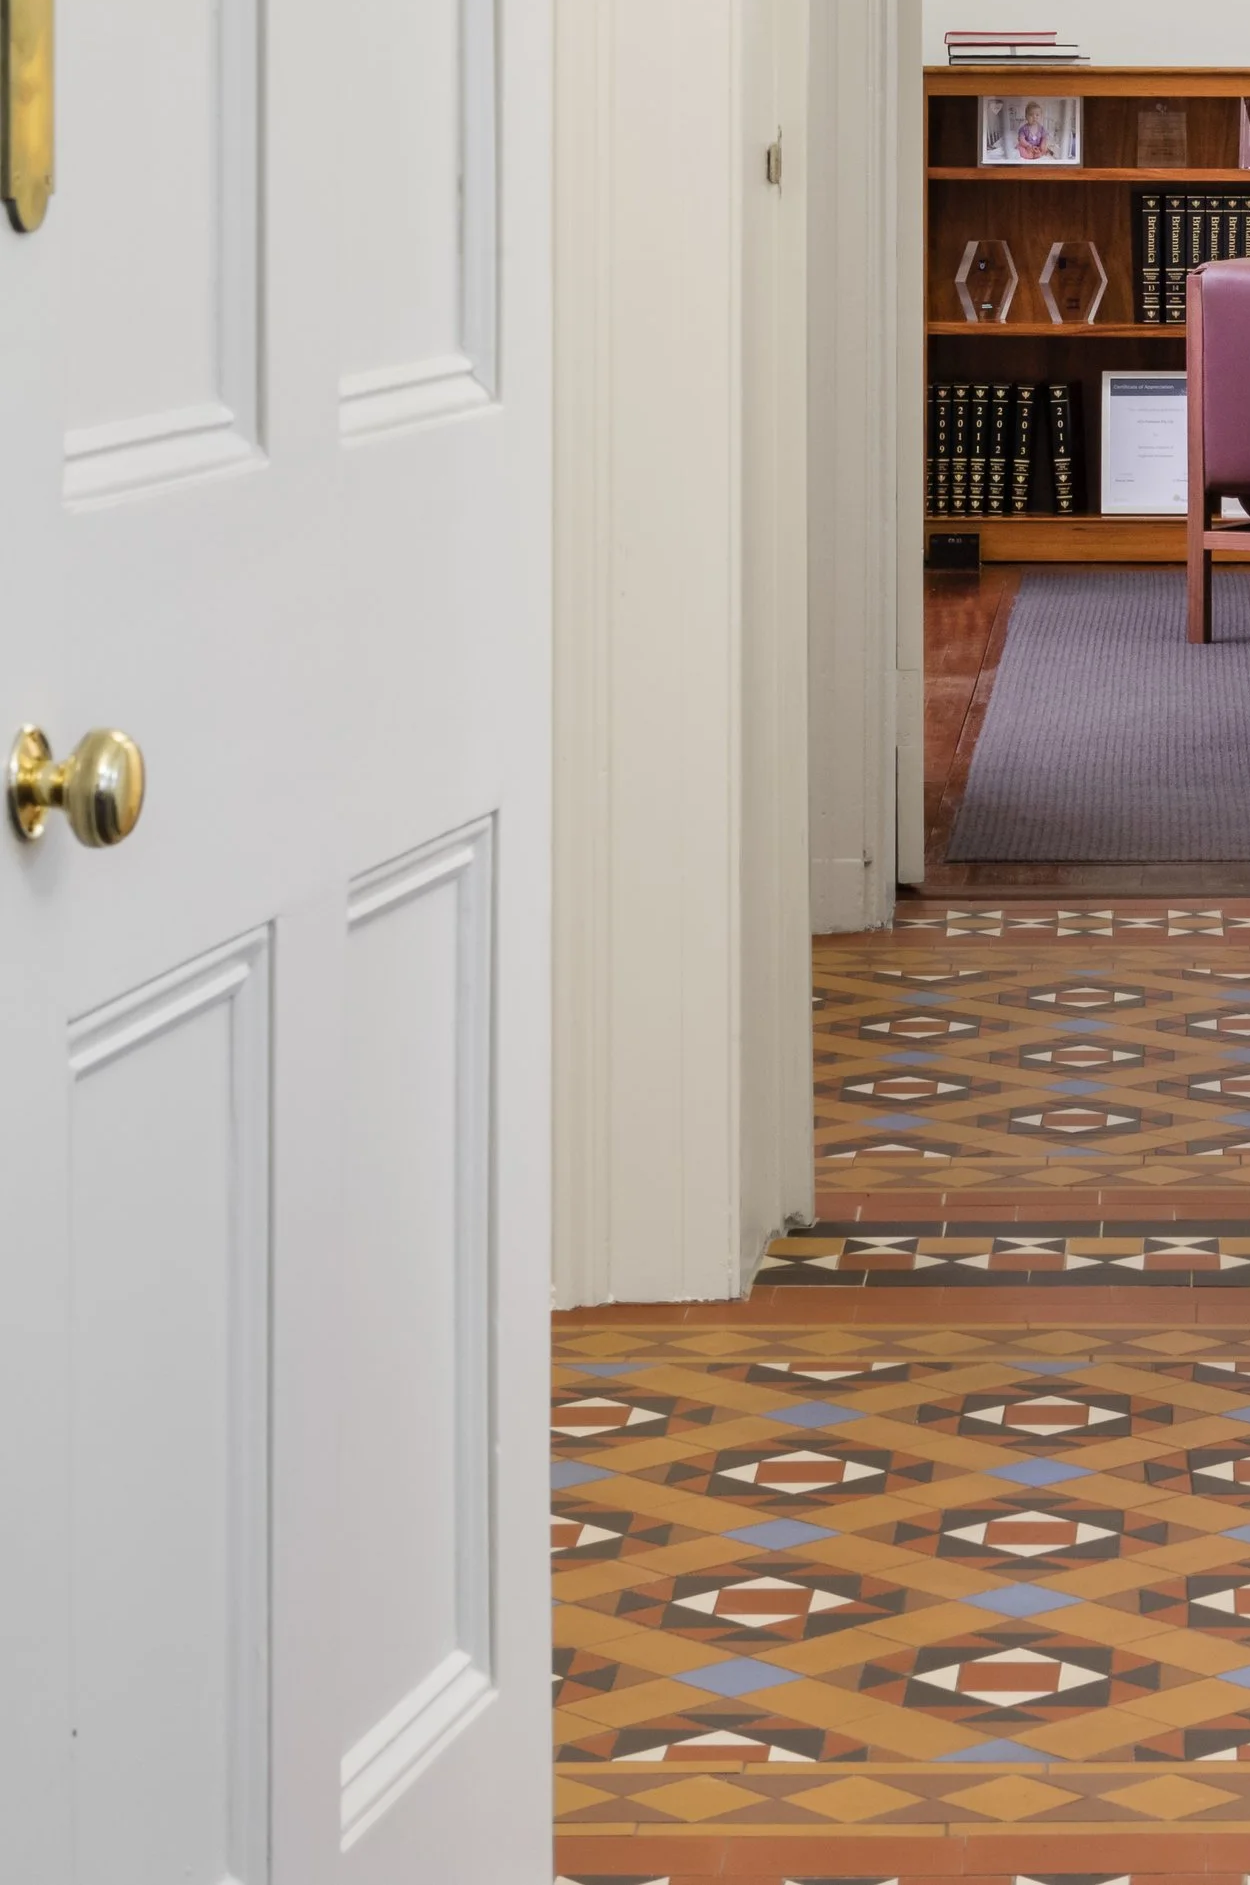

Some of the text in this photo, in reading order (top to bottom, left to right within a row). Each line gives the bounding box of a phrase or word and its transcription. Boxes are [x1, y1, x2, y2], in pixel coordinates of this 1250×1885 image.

[1148, 217, 1156, 263] Britannica
[1172, 217, 1180, 263] Britannica
[1193, 217, 1201, 263] Britannica
[1229, 217, 1237, 259] Britannic
[956, 406, 964, 454] 2010
[975, 407, 983, 454] 2011
[995, 407, 1003, 454] 2012
[1020, 408, 1028, 455] 2013
[1056, 407, 1065, 454] 2014
